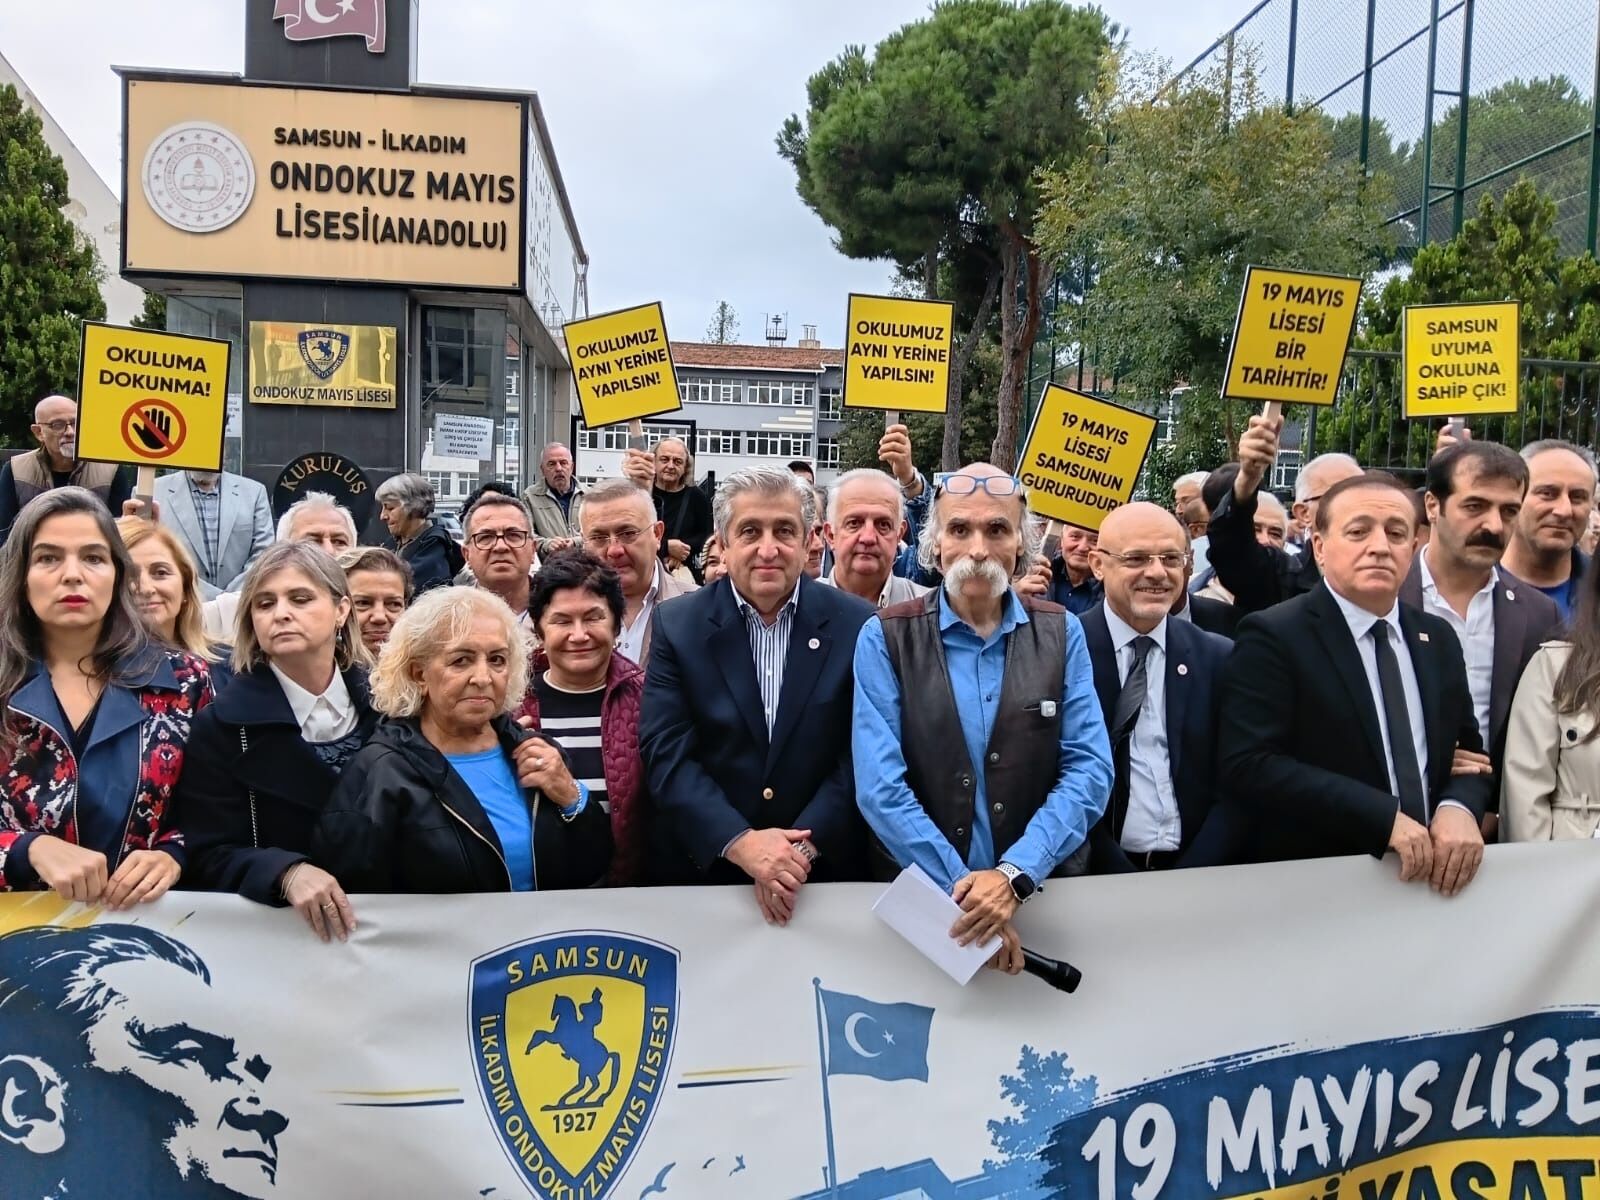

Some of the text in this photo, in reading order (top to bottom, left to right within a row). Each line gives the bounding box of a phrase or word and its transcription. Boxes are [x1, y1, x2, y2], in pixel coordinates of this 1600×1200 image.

[274, 127, 361, 149] SAMSUN
[382, 128, 466, 155] İLKADIM
[270, 160, 415, 198] ONDOKUZ
[426, 170, 515, 204] MAYIS
[1262, 282, 1345, 308] 19 MAYIS
[856, 320, 945, 341] OKULUMUZ
[1268, 308, 1326, 335] LİSESİ
[1426, 318, 1498, 336] SAMSUN
[576, 328, 659, 359] OKULUMUZ
[850, 342, 947, 363] AYNI YERİNE
[1275, 337, 1307, 361] BİR
[1431, 340, 1494, 357] UYUMA
[106, 346, 207, 373] OKULUMA
[578, 348, 668, 381] AYNI YERİNE
[1418, 361, 1501, 379] OKULUNA
[99, 368, 211, 397] DOKUNMA!
[591, 371, 661, 398] YAPILSIN!
[861, 364, 934, 384] YAPILSIN!
[1241, 365, 1328, 391] TARİHTİR!
[253, 385, 392, 403] ONDOKUZ MAYIS LİSESİ
[1417, 382, 1506, 401] SAHİP ÇIK!
[1061, 411, 1129, 446] 19 MAYIS
[1063, 436, 1112, 464] LİSESİ
[280, 455, 368, 494] KURULUŞ
[1035, 452, 1124, 491] SAMSUNUN
[506, 946, 649, 984] SAMSUN
[479, 1014, 514, 1115] İLKADIM
[595, 1096, 646, 1180] MAYIS
[638, 1006, 669, 1093] LİSESİ
[552, 1111, 597, 1134] 1927
[1081, 1102, 1177, 1200] 19
[1205, 1060, 1441, 1191] MAYIS
